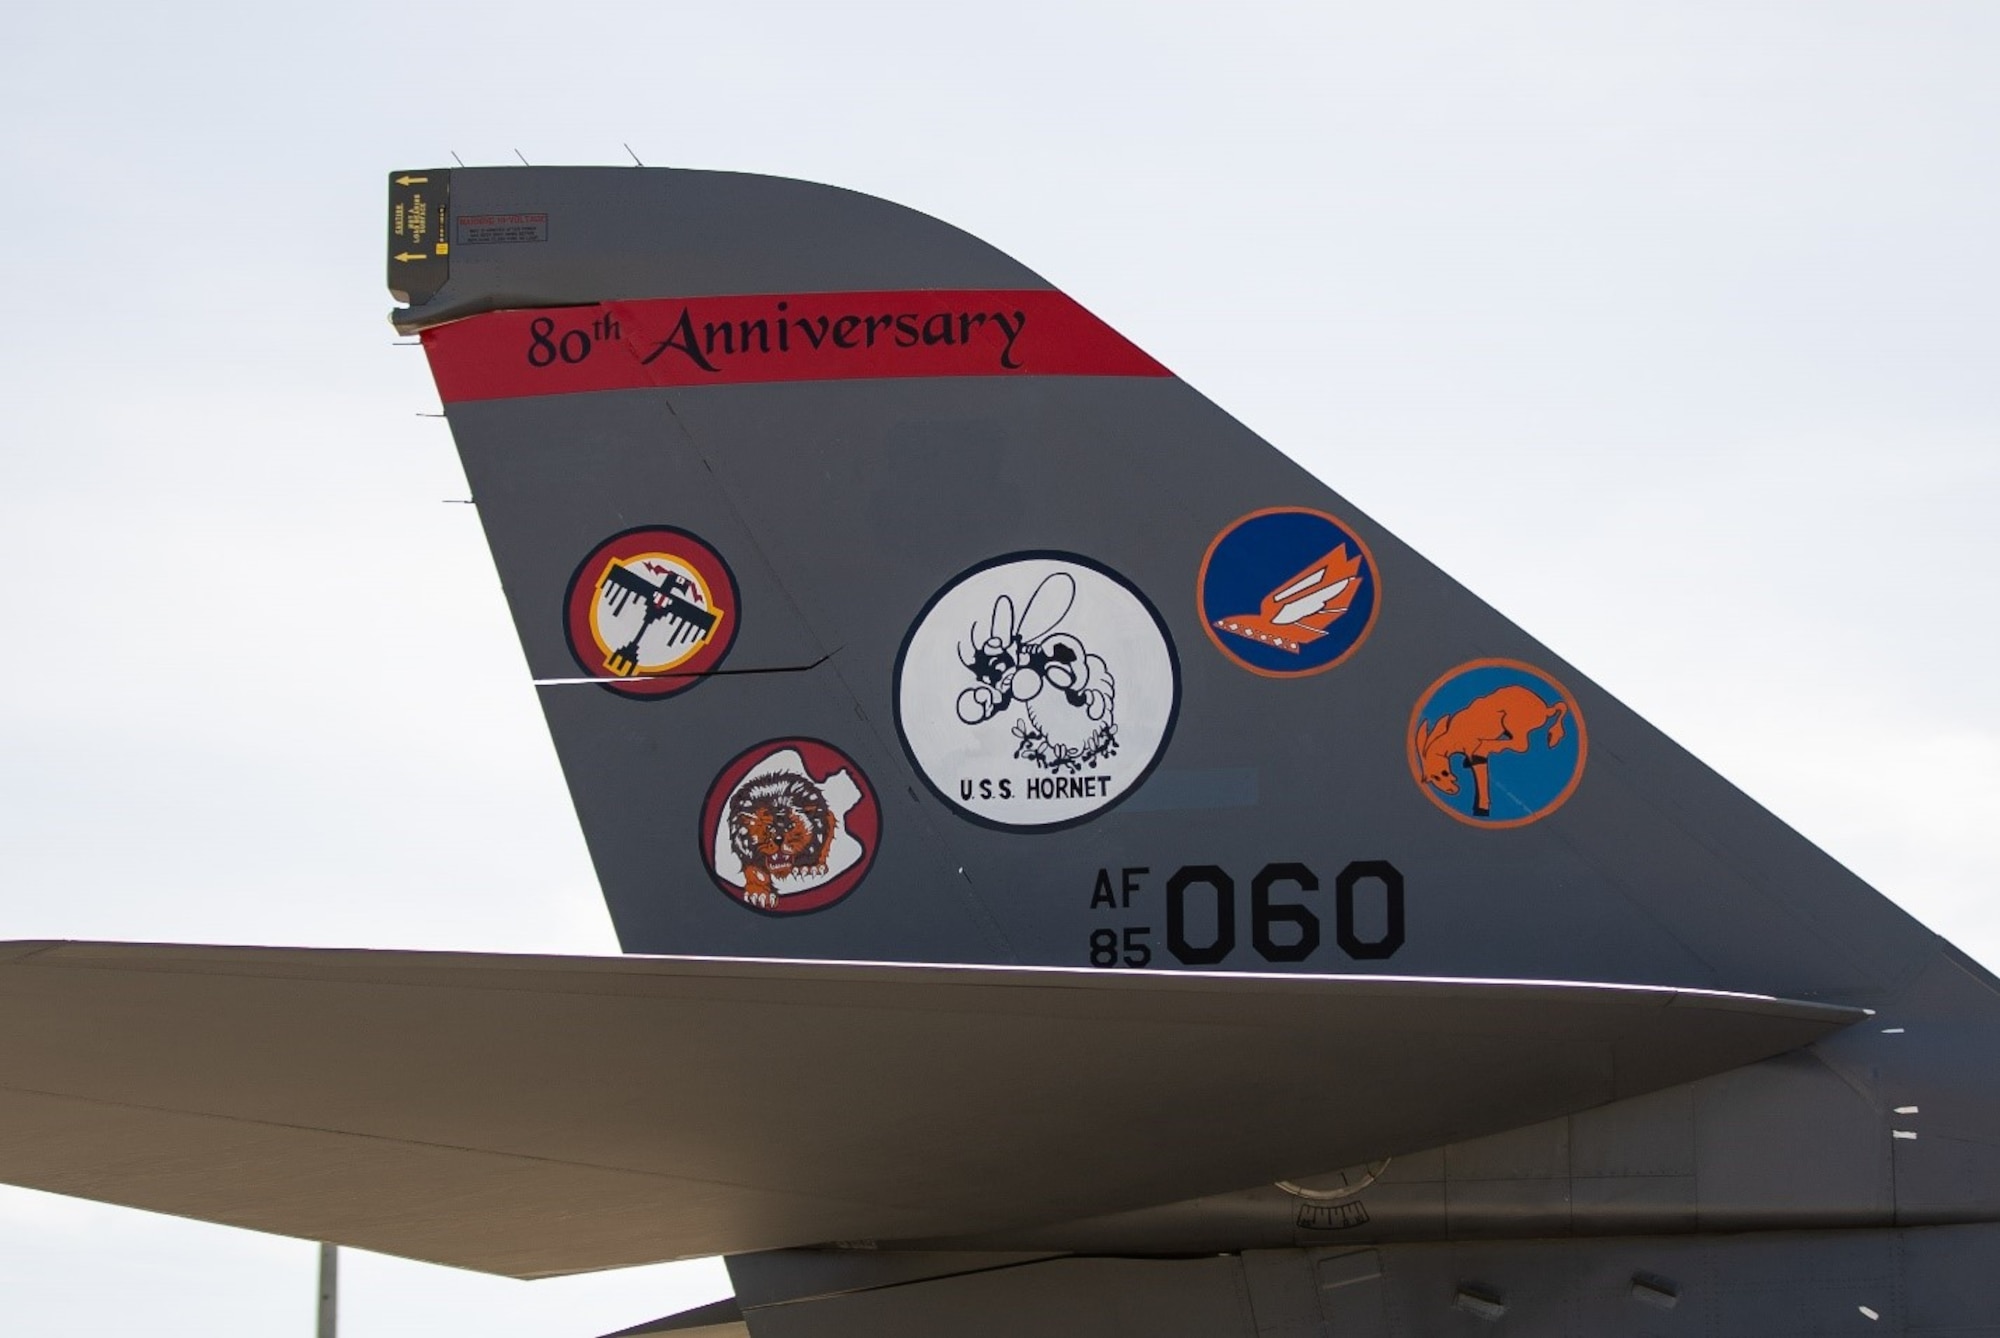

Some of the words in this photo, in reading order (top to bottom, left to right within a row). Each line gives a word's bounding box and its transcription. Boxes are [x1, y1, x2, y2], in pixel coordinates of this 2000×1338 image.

[528, 312, 621, 368] 80th
[641, 301, 1026, 372] Anniversary
[960, 778, 1015, 801] U.S.S.
[1027, 776, 1111, 800] HORNET
[1090, 867, 1149, 909] AF
[1166, 860, 1405, 965] 060
[1090, 927, 1151, 968] 85
